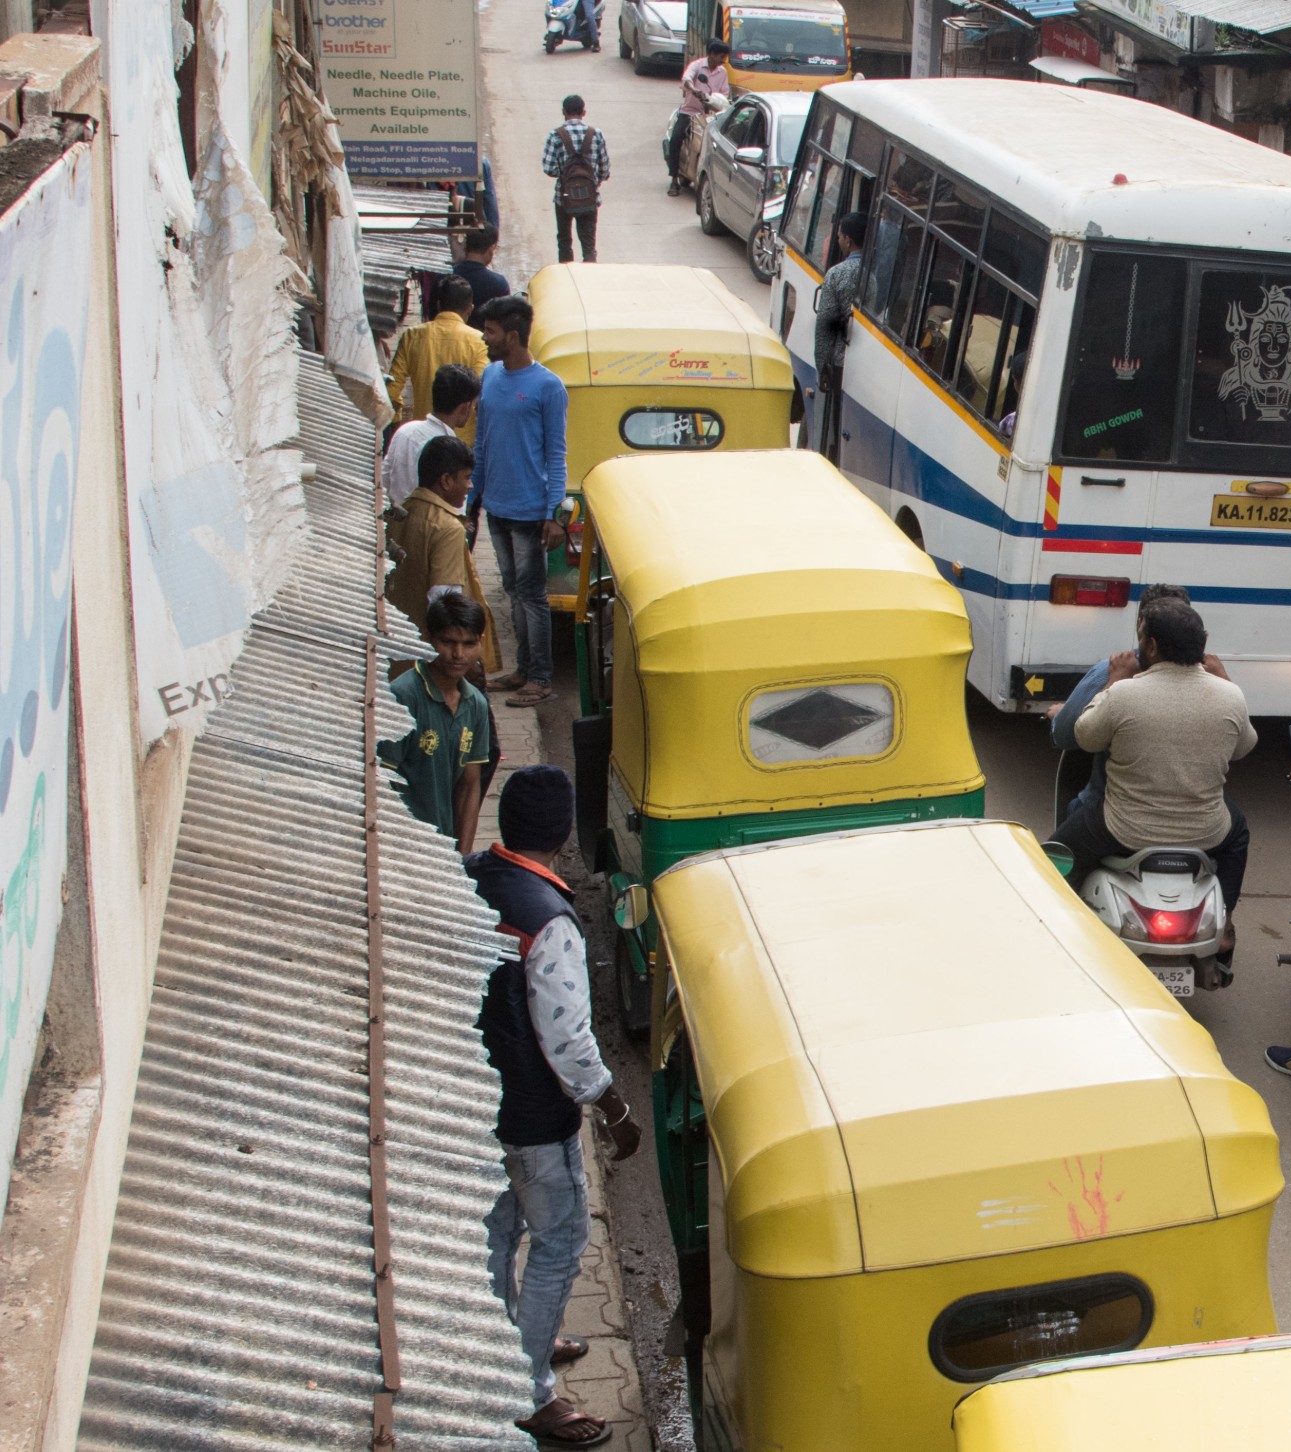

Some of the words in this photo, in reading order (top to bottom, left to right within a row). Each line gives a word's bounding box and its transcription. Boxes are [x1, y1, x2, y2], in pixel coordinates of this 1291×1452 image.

[325, 14, 387, 28] brother
[322, 40, 392, 54] SunStar
[327, 69, 376, 81] Needle,
[380, 70, 424, 80] Needle
[428, 71, 464, 82] Plate,
[353, 88, 407, 98] Machine
[411, 88, 440, 100] Oile,
[390, 107, 471, 118] Equipments,
[370, 124, 429, 134] Available
[363, 146, 387, 154] Road,
[1083, 421, 1107, 438] ABHI
[1108, 408, 1144, 428] GOWDA
[1153, 972, 1184, 982] A-52
